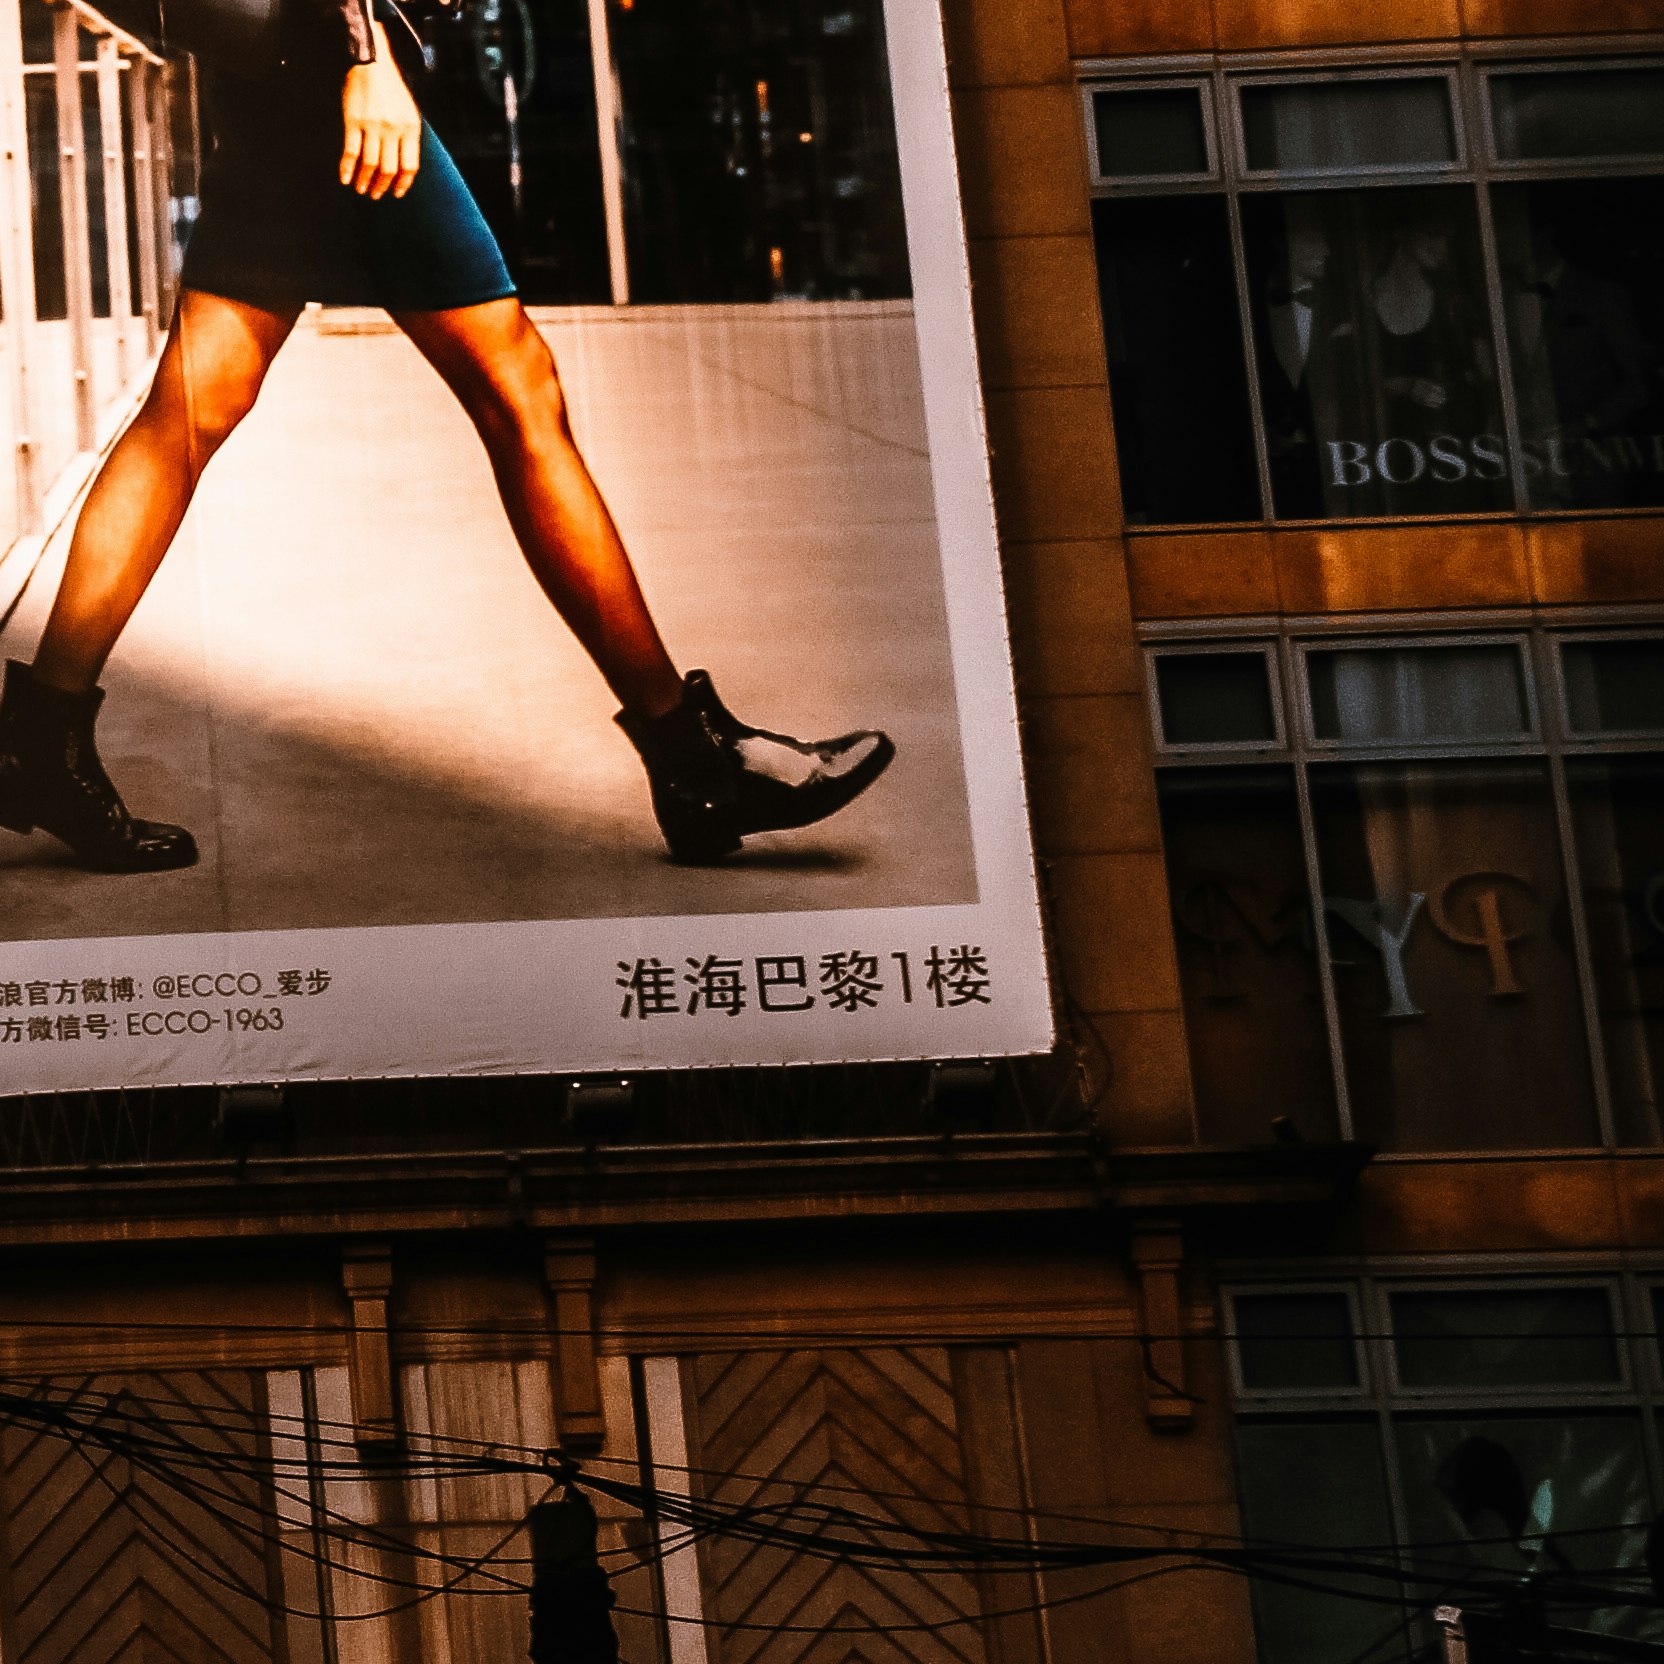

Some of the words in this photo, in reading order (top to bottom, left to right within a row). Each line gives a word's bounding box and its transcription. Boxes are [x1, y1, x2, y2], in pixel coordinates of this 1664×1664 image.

[152, 967, 333, 1001] @ECCO_爱步
[615, 944, 992, 1020] 淮海巴黎1楼
[127, 1007, 285, 1037] ECCO-1963
